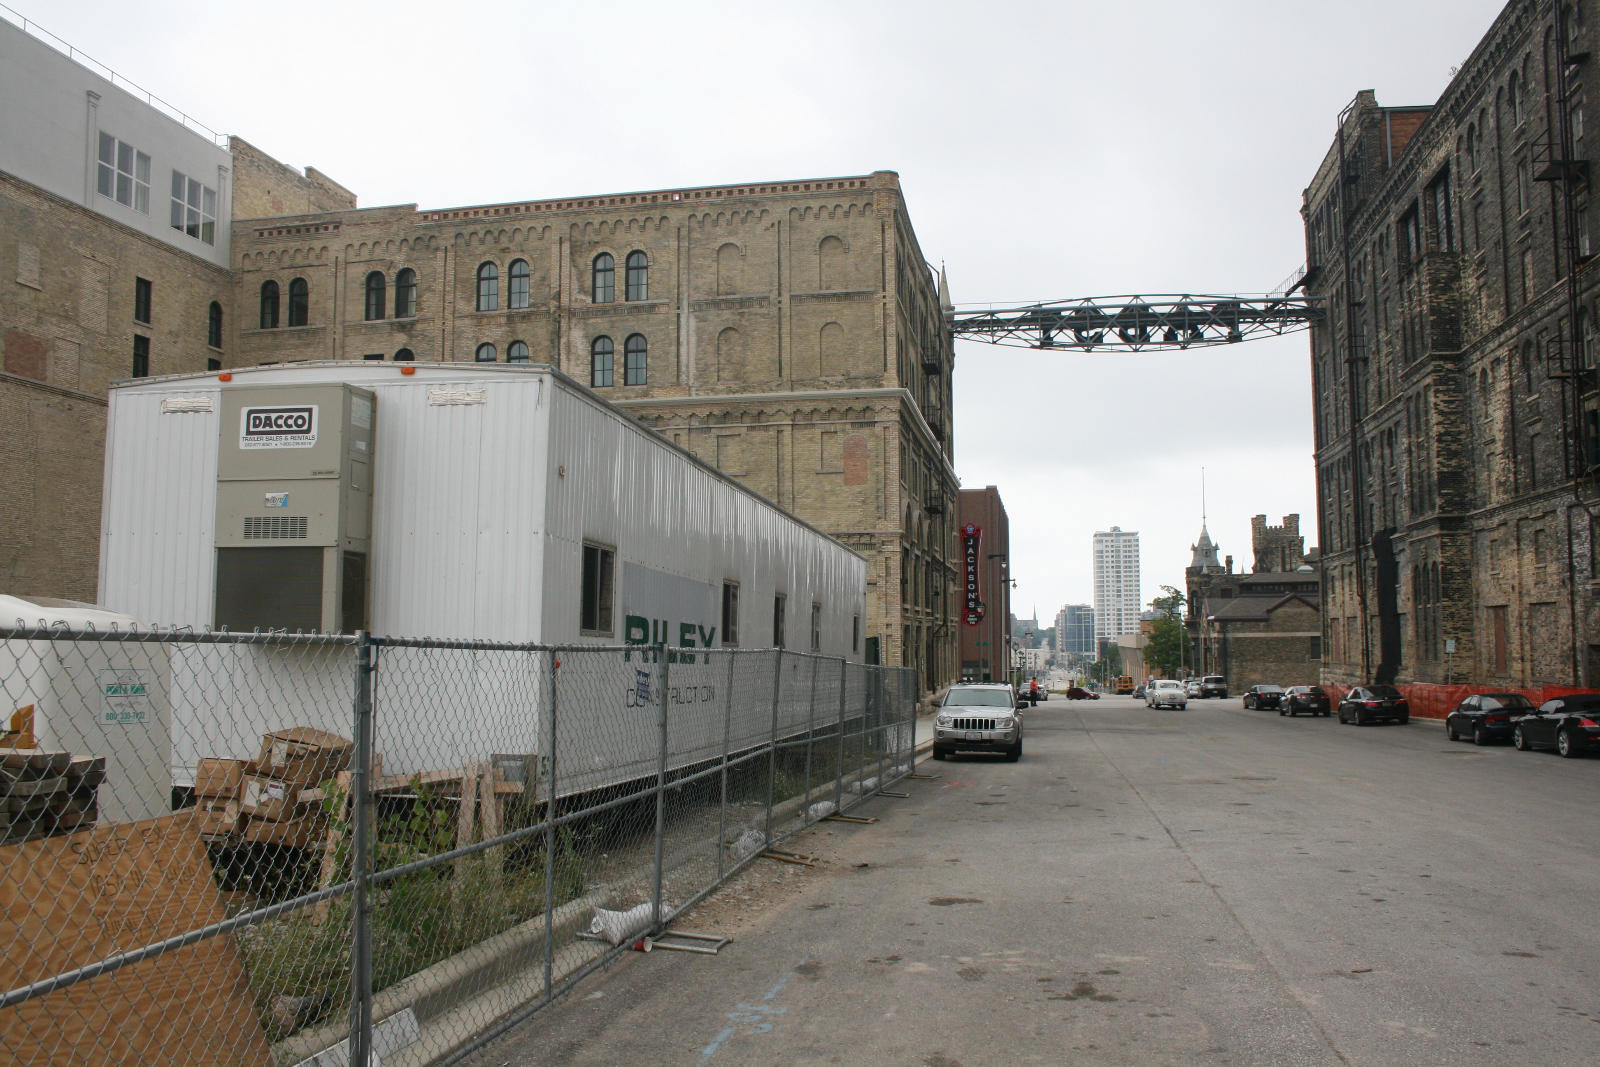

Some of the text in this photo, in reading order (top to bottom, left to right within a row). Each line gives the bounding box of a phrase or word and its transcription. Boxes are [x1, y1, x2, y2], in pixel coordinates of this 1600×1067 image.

[252, 414, 307, 429] DACCO
[967, 538, 978, 608] JACKSON'S
[625, 615, 716, 664] RILEY
